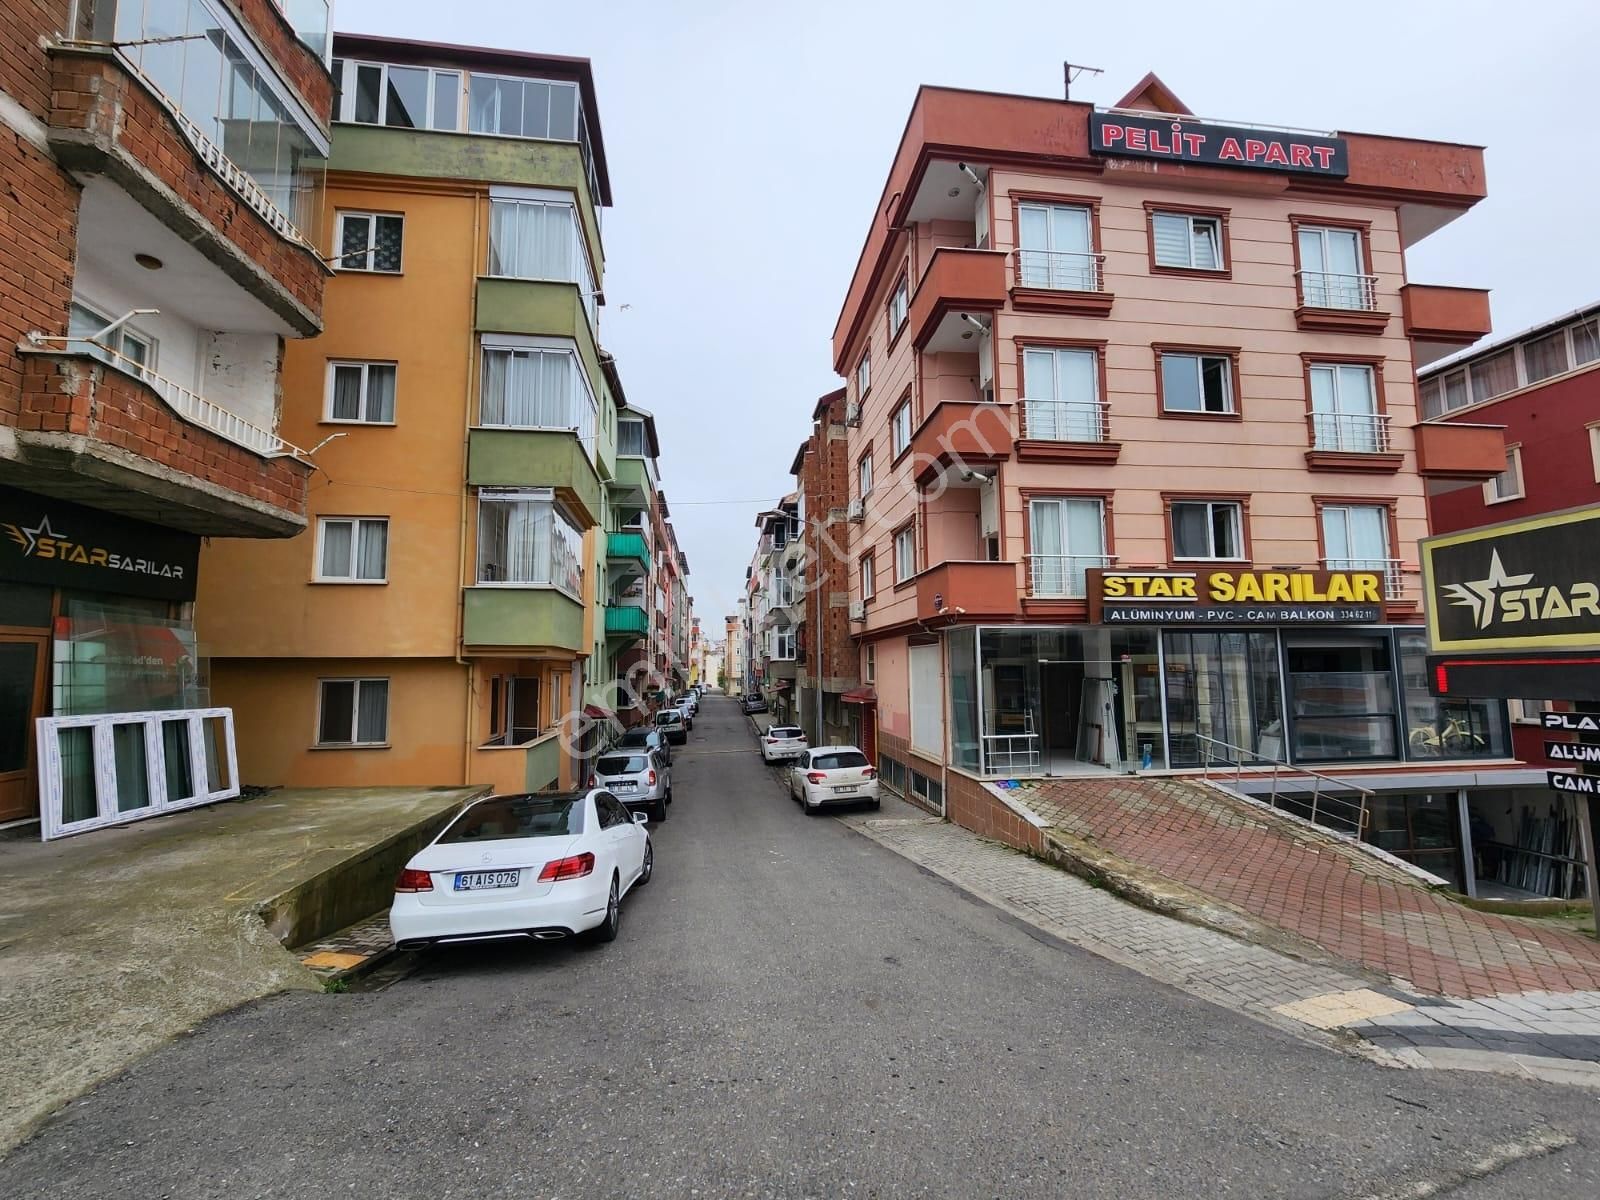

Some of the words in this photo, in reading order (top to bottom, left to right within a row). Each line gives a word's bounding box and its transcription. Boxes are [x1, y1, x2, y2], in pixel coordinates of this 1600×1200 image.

[1101, 123, 1206, 157] PELİT
[1219, 137, 1335, 169] APART
[1103, 577, 1197, 597] STAR
[1209, 572, 1381, 602] SARILAR
[1500, 582, 1600, 623] STAR
[1207, 610, 1234, 620] PVC
[1247, 610, 1276, 620] CAM
[1280, 610, 1335, 620] BALKON
[1545, 714, 1600, 730] PLA
[1553, 774, 1593, 793] CAM
[461, 875, 473, 886] 61
[496, 872, 517, 884] 076
